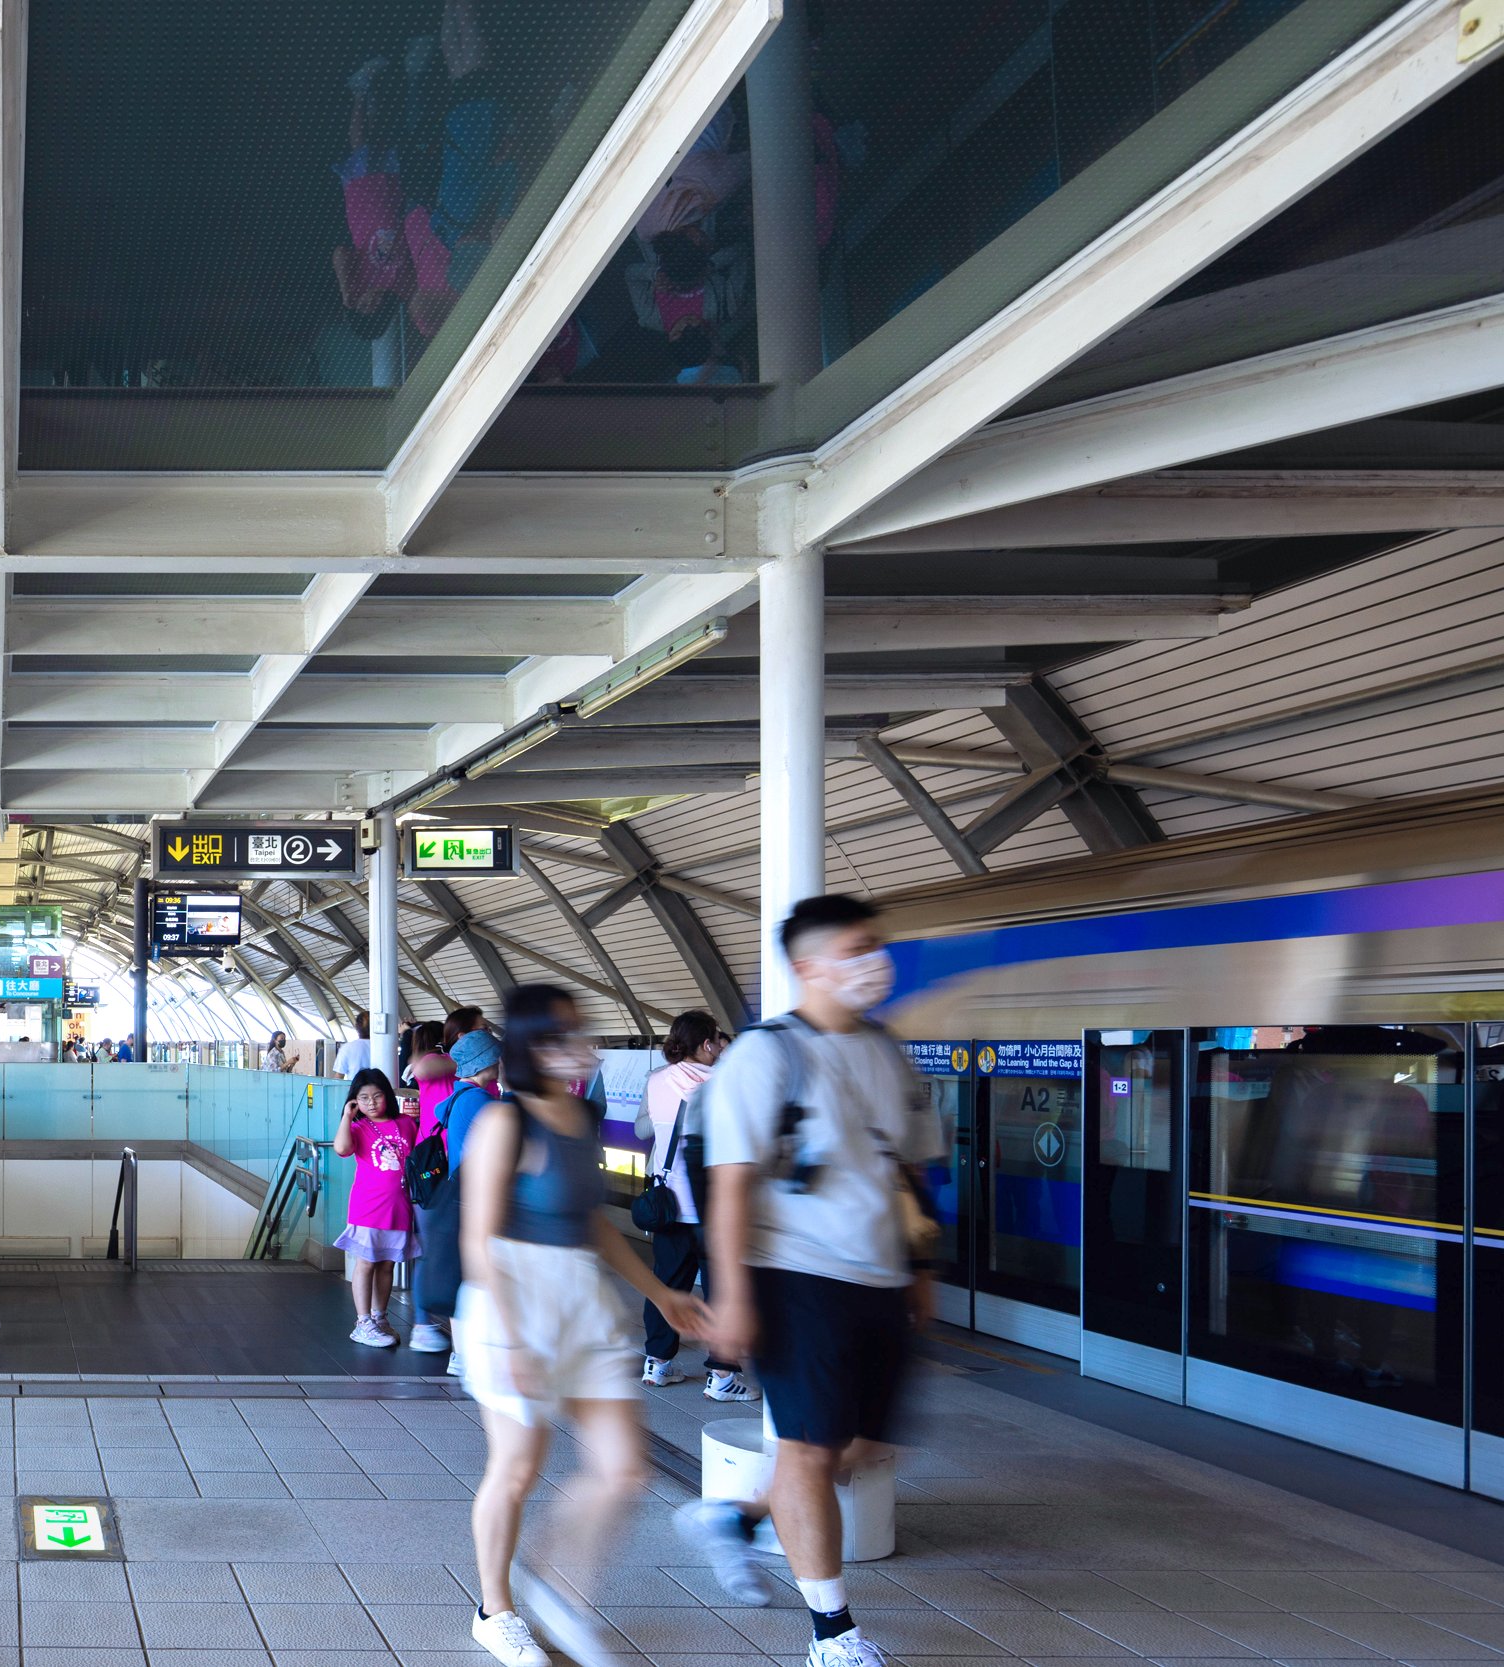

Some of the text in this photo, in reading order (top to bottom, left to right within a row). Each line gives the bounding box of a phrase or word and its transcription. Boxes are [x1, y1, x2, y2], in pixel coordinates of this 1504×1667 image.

[193, 834, 222, 853] 出口
[252, 836, 278, 849] 臺北
[193, 853, 222, 864] EXIT
[998, 1045, 1022, 1057] 勿倚門
[915, 1057, 934, 1066] Closing
[1007, 1059, 1029, 1068] Leaning
[1033, 1059, 1048, 1067] Mind
[1048, 1059, 1058, 1067] the
[1059, 1059, 1073, 1069] Gap
[1021, 1086, 1050, 1112] A2
